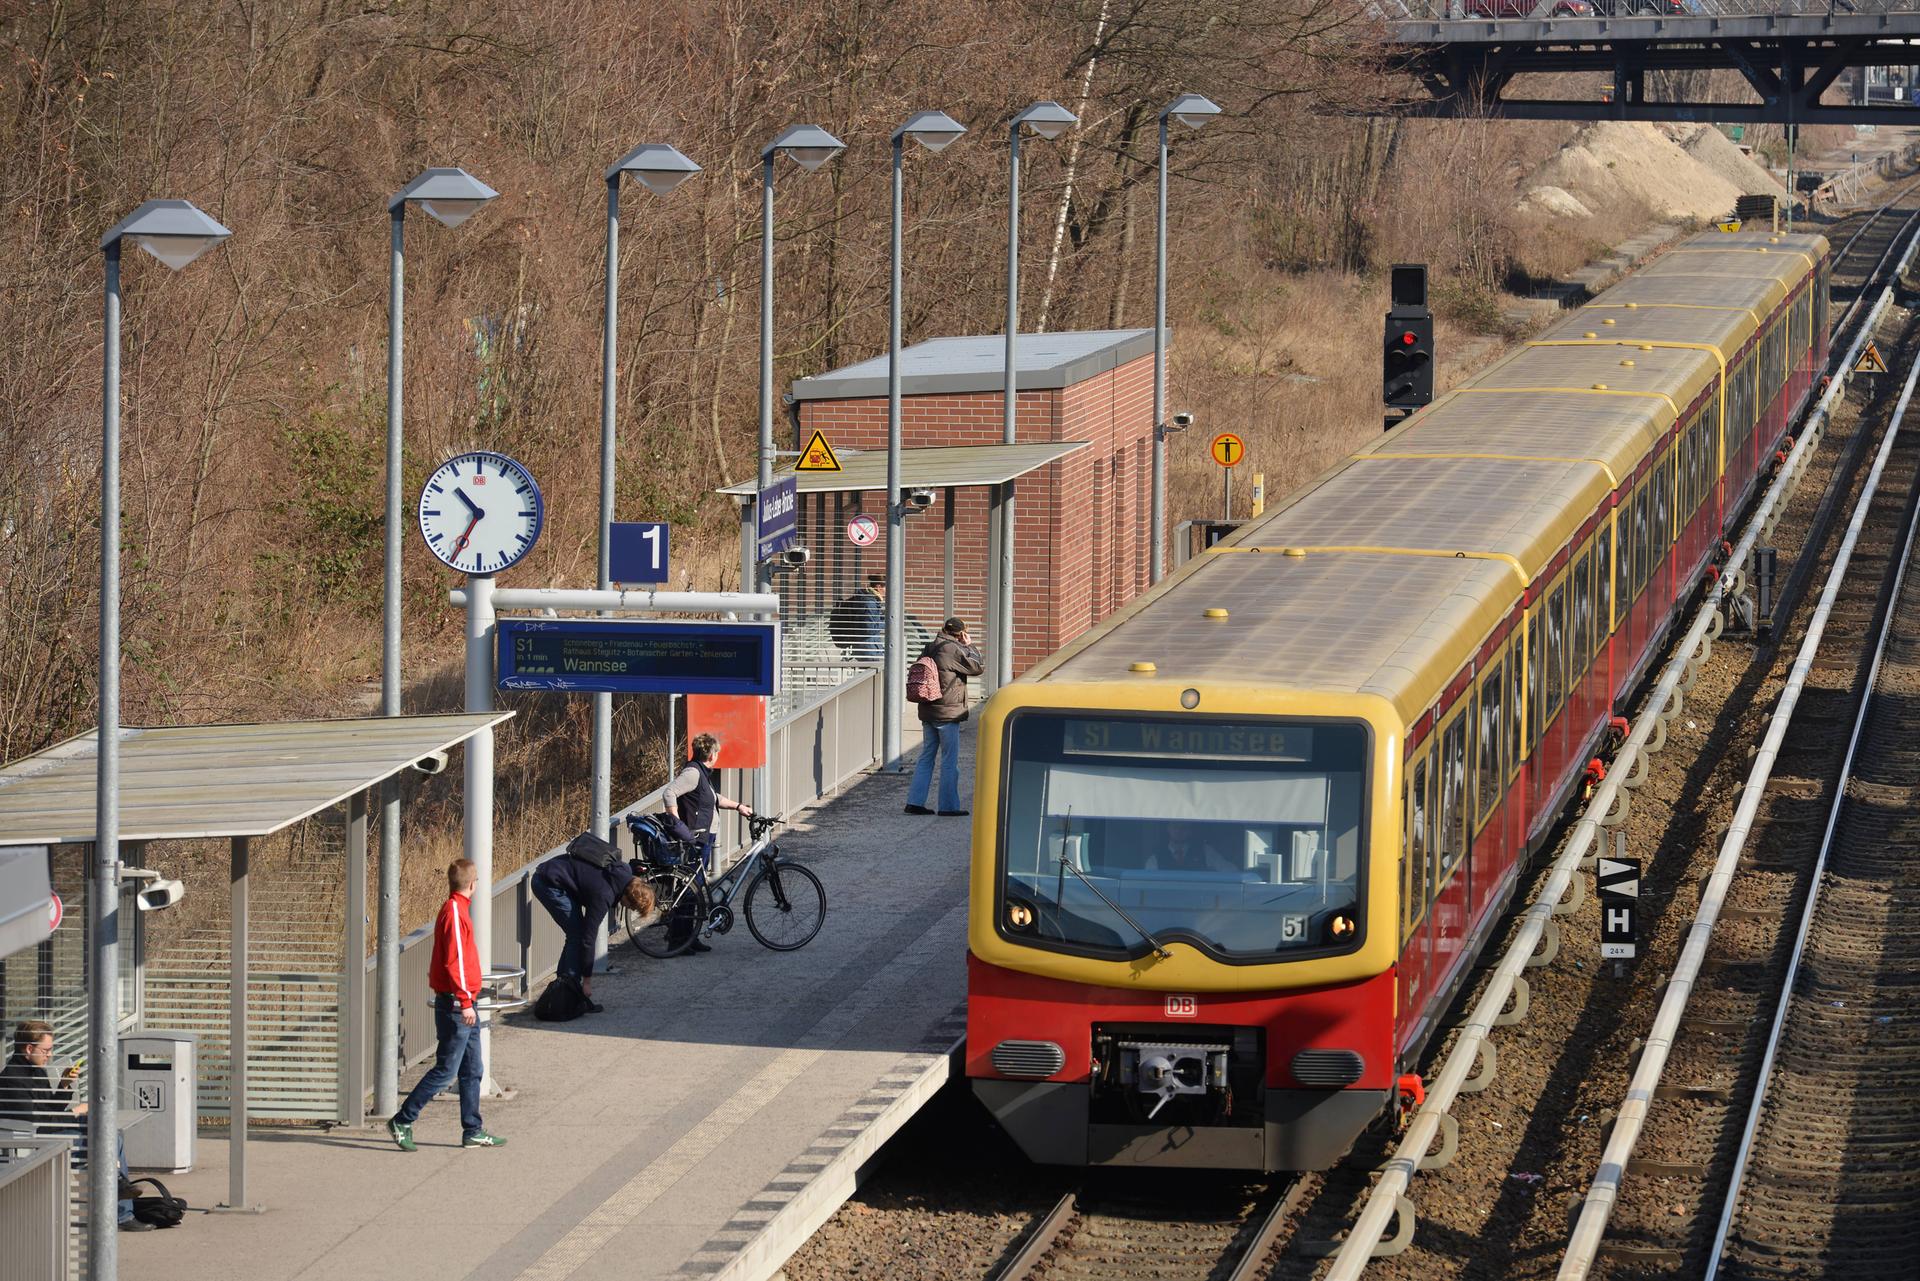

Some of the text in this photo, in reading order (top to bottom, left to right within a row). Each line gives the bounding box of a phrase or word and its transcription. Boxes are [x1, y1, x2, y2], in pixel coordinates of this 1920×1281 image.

[1865, 352, 1875, 370] 5
[642, 525, 660, 569] 1
[516, 638, 534, 652] S1
[563, 658, 628, 673] Wannsee
[1085, 723, 1286, 753] S1 Wannsee
[1284, 917, 1305, 938] 51
[1608, 908, 1629, 933] H
[1168, 997, 1194, 1013] DB
